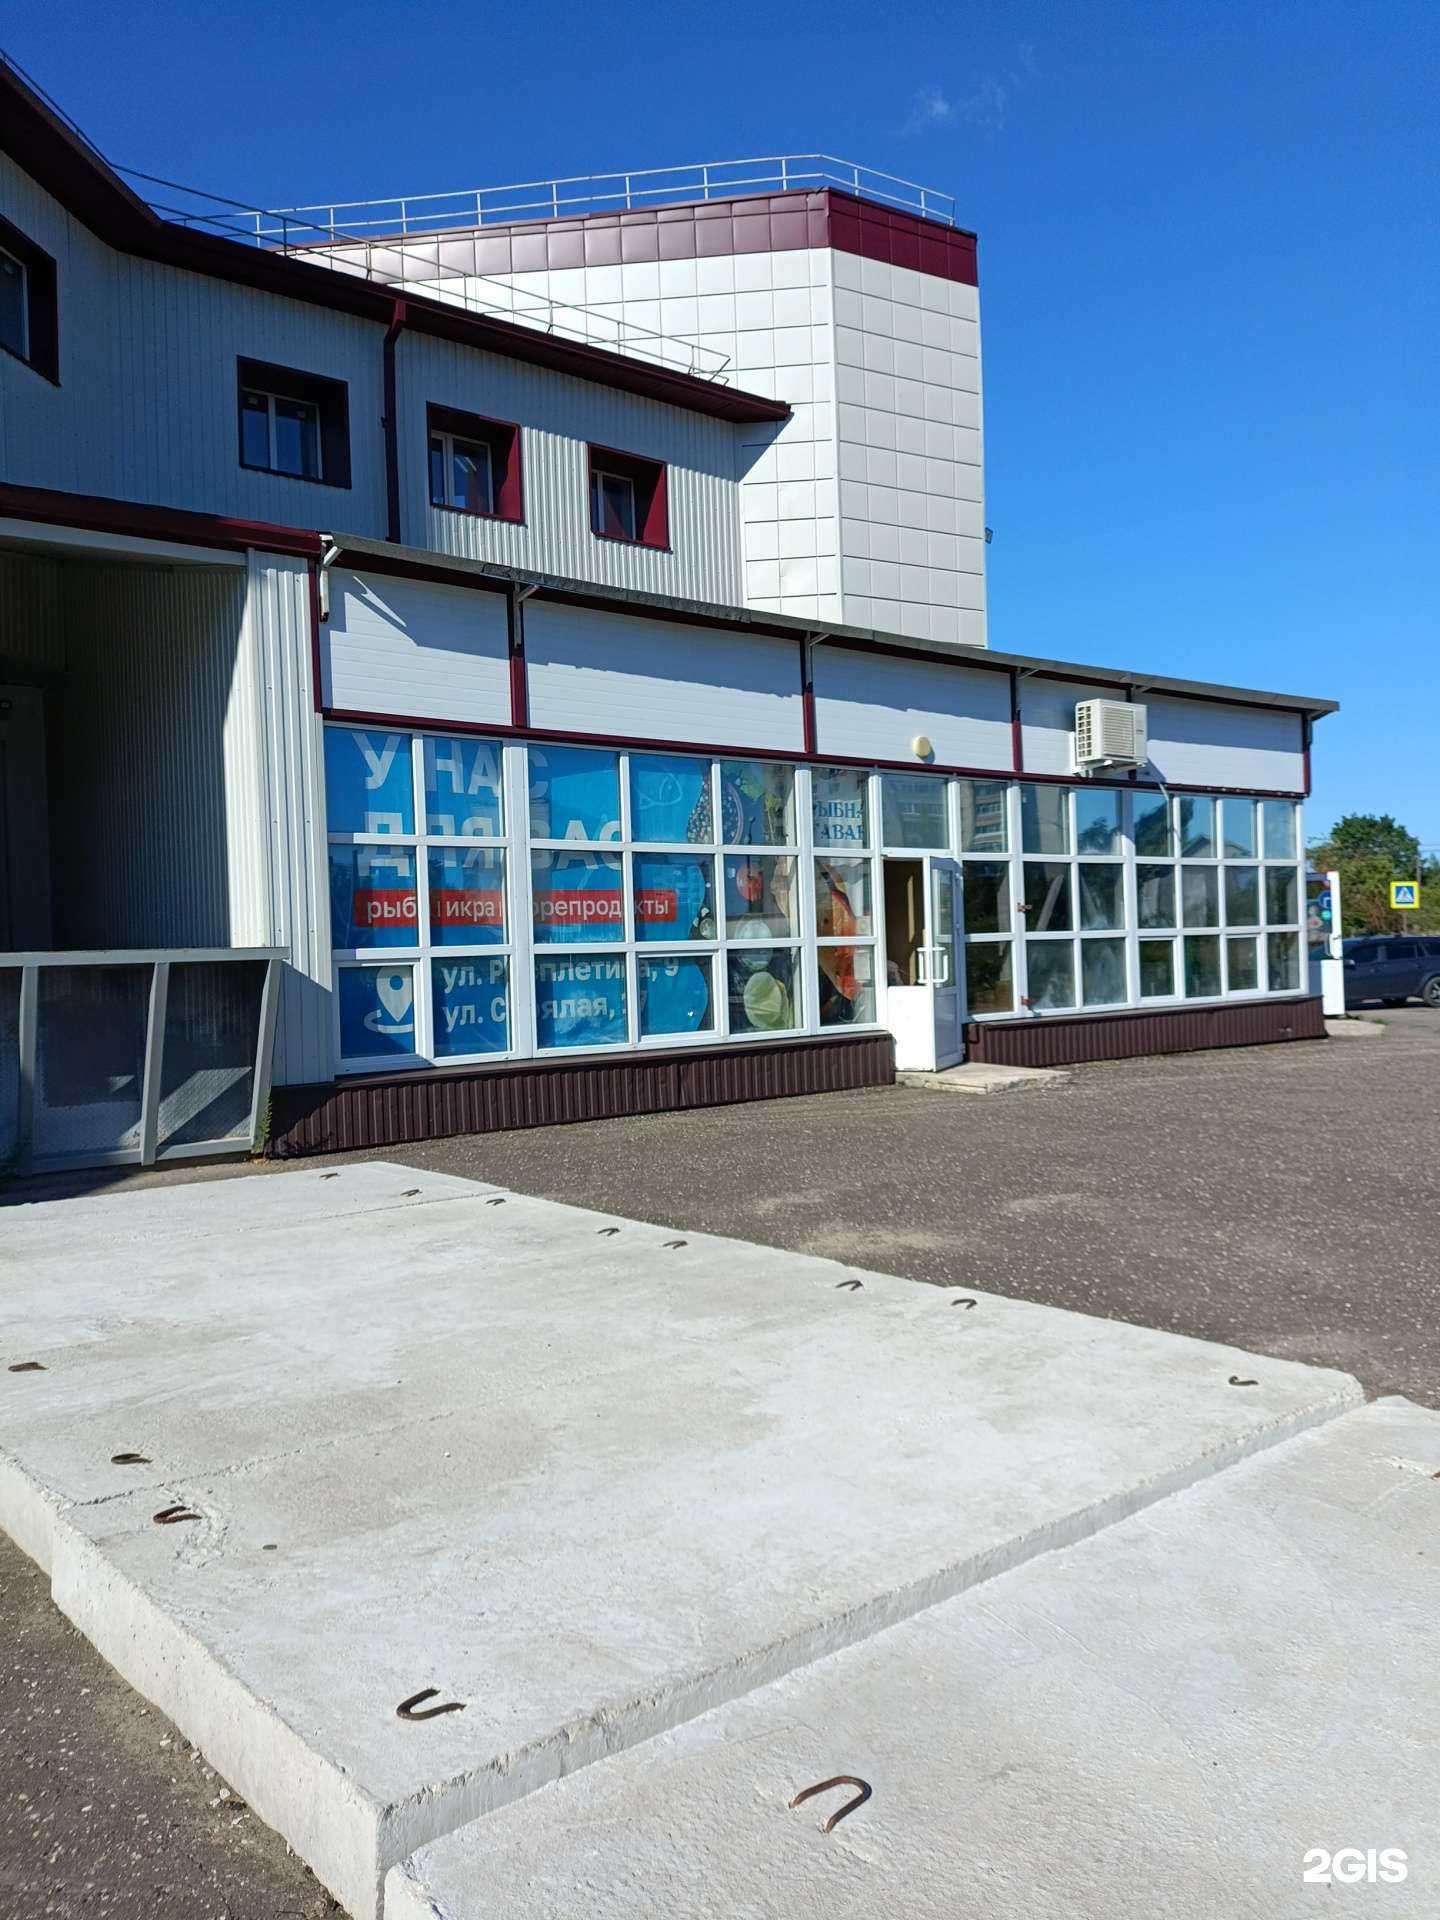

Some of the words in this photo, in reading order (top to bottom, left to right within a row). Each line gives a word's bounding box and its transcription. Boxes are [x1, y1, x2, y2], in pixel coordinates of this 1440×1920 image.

[352, 732, 401, 790] У
[367, 896, 418, 919] рыб
[446, 900, 494, 922] икра
[441, 964, 483, 994] ул.
[442, 1003, 484, 1033] ул.
